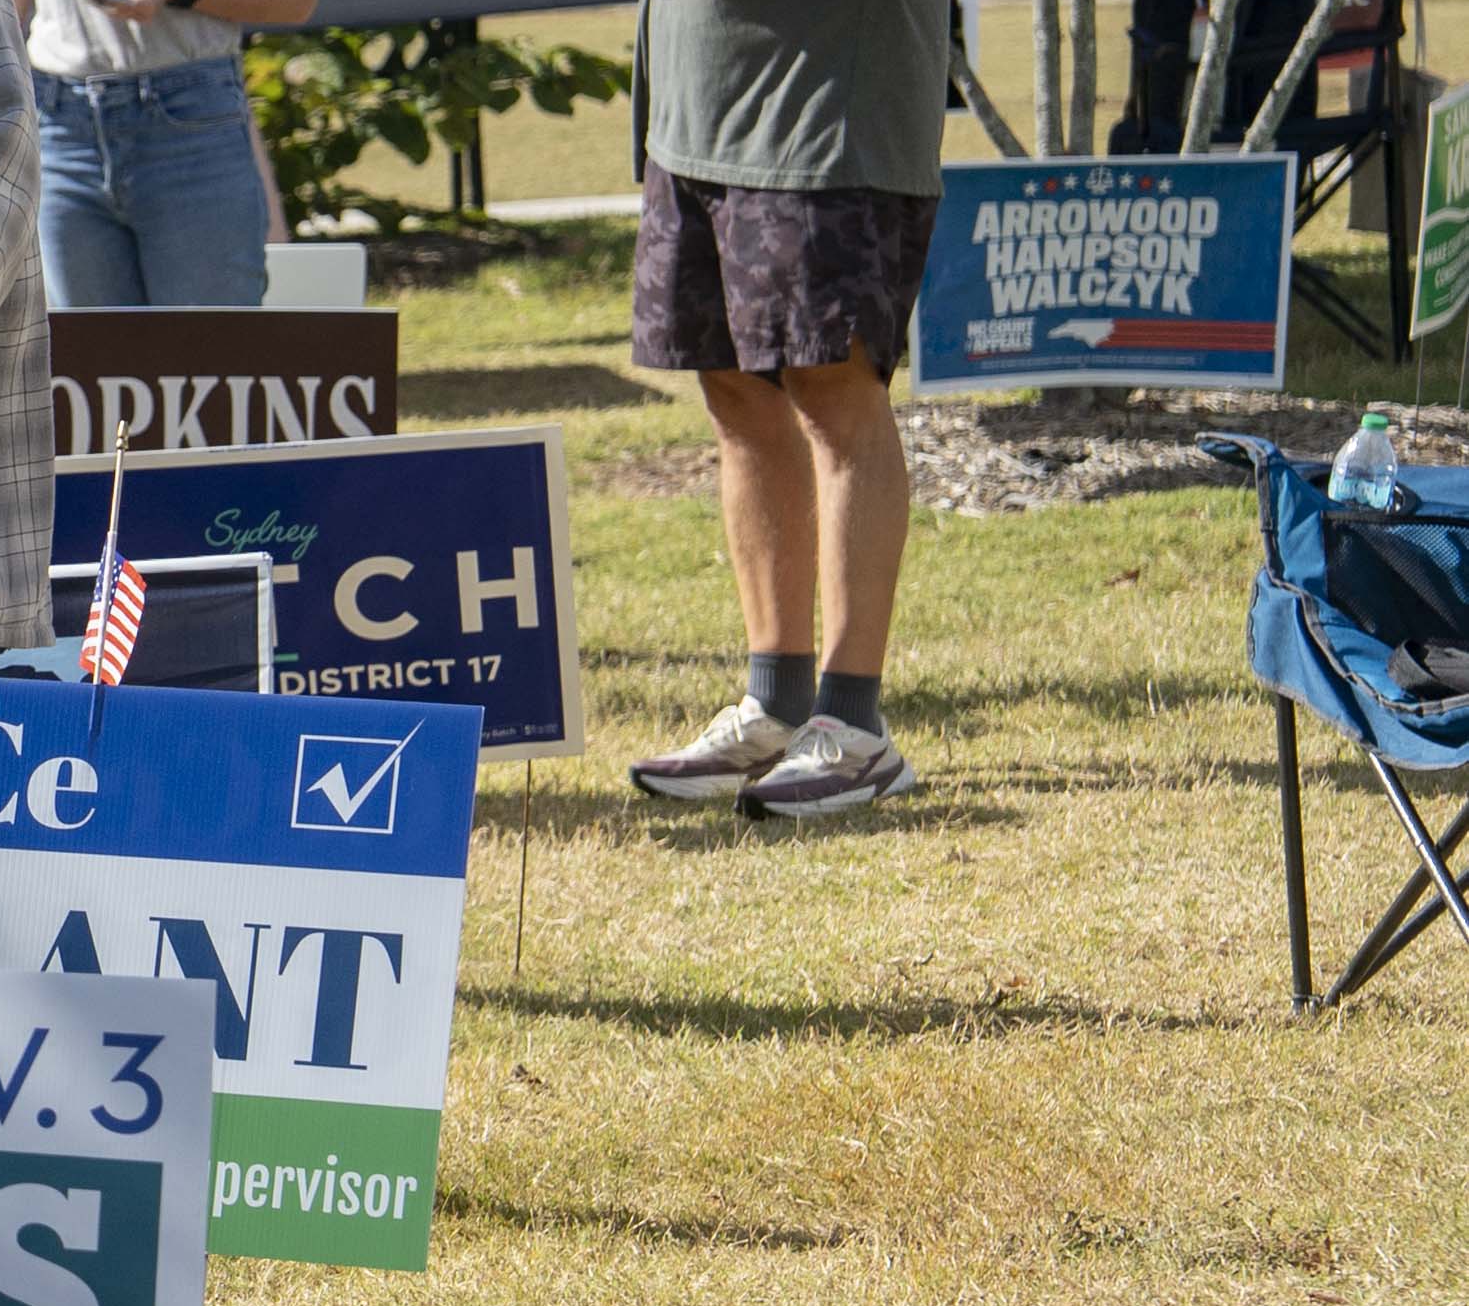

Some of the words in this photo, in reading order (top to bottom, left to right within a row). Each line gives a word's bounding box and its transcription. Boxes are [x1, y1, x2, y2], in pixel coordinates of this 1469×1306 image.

[972, 196, 1220, 244] ARROWOOD
[986, 233, 1202, 282] HAMPSON
[990, 268, 1193, 318] WALCZYK
[204, 508, 319, 560] Sydney
[281, 658, 454, 697] DISTRICT
[467, 655, 502, 683] 17
[100, 1031, 165, 1135] 3
